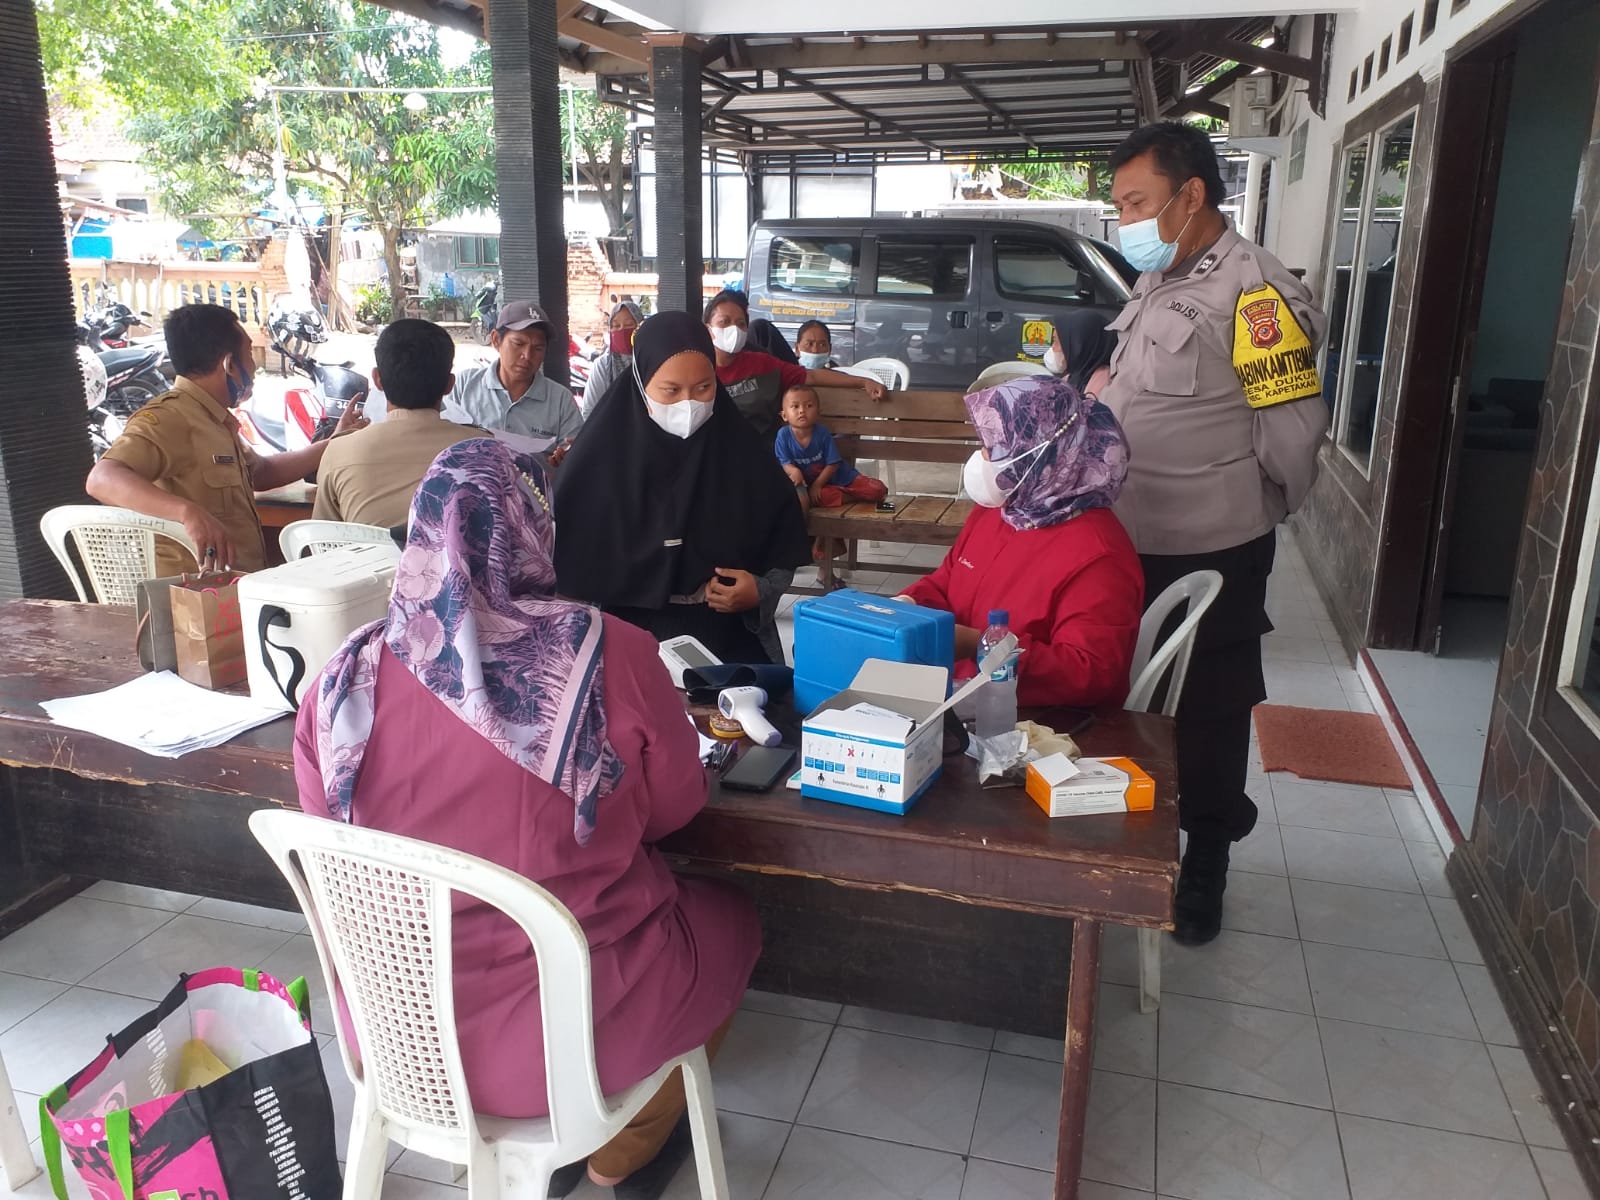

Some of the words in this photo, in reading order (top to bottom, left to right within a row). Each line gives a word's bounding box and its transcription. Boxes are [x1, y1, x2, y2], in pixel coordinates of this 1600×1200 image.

[1168, 300, 1199, 320] POLISI
[1245, 384, 1269, 395] ESA
[1275, 371, 1316, 387] DUKUH
[1265, 380, 1316, 398] KAPETAKAN
